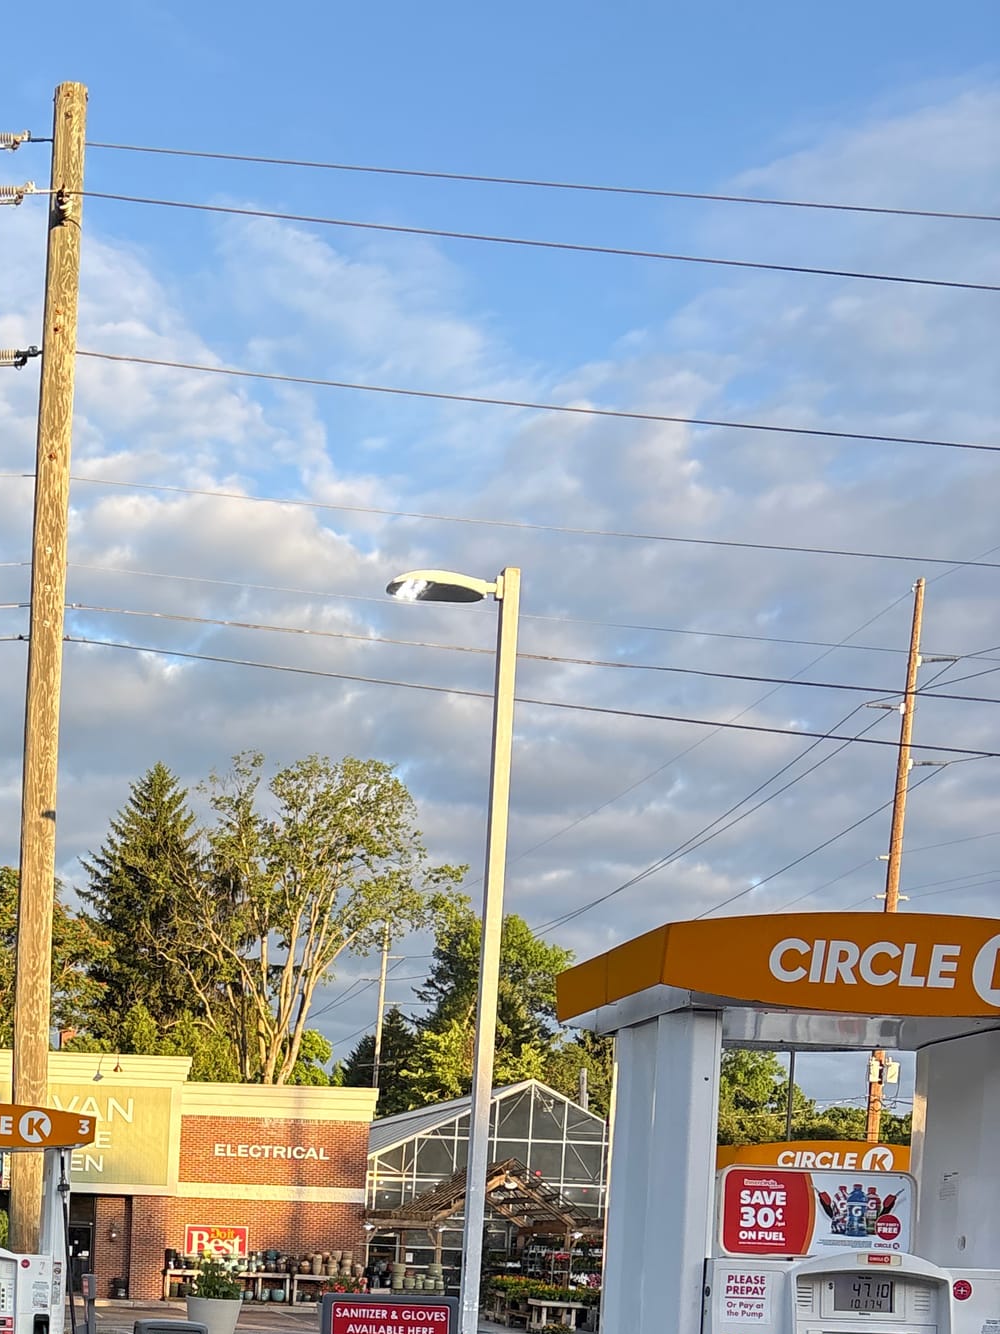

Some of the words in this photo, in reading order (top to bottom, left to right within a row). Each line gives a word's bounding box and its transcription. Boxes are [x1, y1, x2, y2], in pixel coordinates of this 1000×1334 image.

[769, 937, 961, 989] CIRCLE
[78, 1119, 90, 1134] 3
[214, 1143, 330, 1160] ELECTRICAL
[777, 1150, 857, 1171] CIRCLE
[740, 1189, 787, 1206] SAVE
[868, 1200, 877, 1209] G
[852, 1206, 862, 1217] G
[210, 1227, 227, 1239] Do
[739, 1230, 757, 1240] ON
[758, 1231, 786, 1241] FUEL
[877, 1226, 898, 1234] FREE
[190, 1230, 243, 1255] Best
[727, 1274, 766, 1285] PLEASE
[726, 1285, 766, 1296] PREPAY
[726, 1301, 736, 1309] Or
[739, 1302, 753, 1311] Pay
[335, 1307, 387, 1320] SANITIZER
[390, 1310, 398, 1320] &
[401, 1310, 446, 1322] GLOVES
[741, 1310, 764, 1319] Pump
